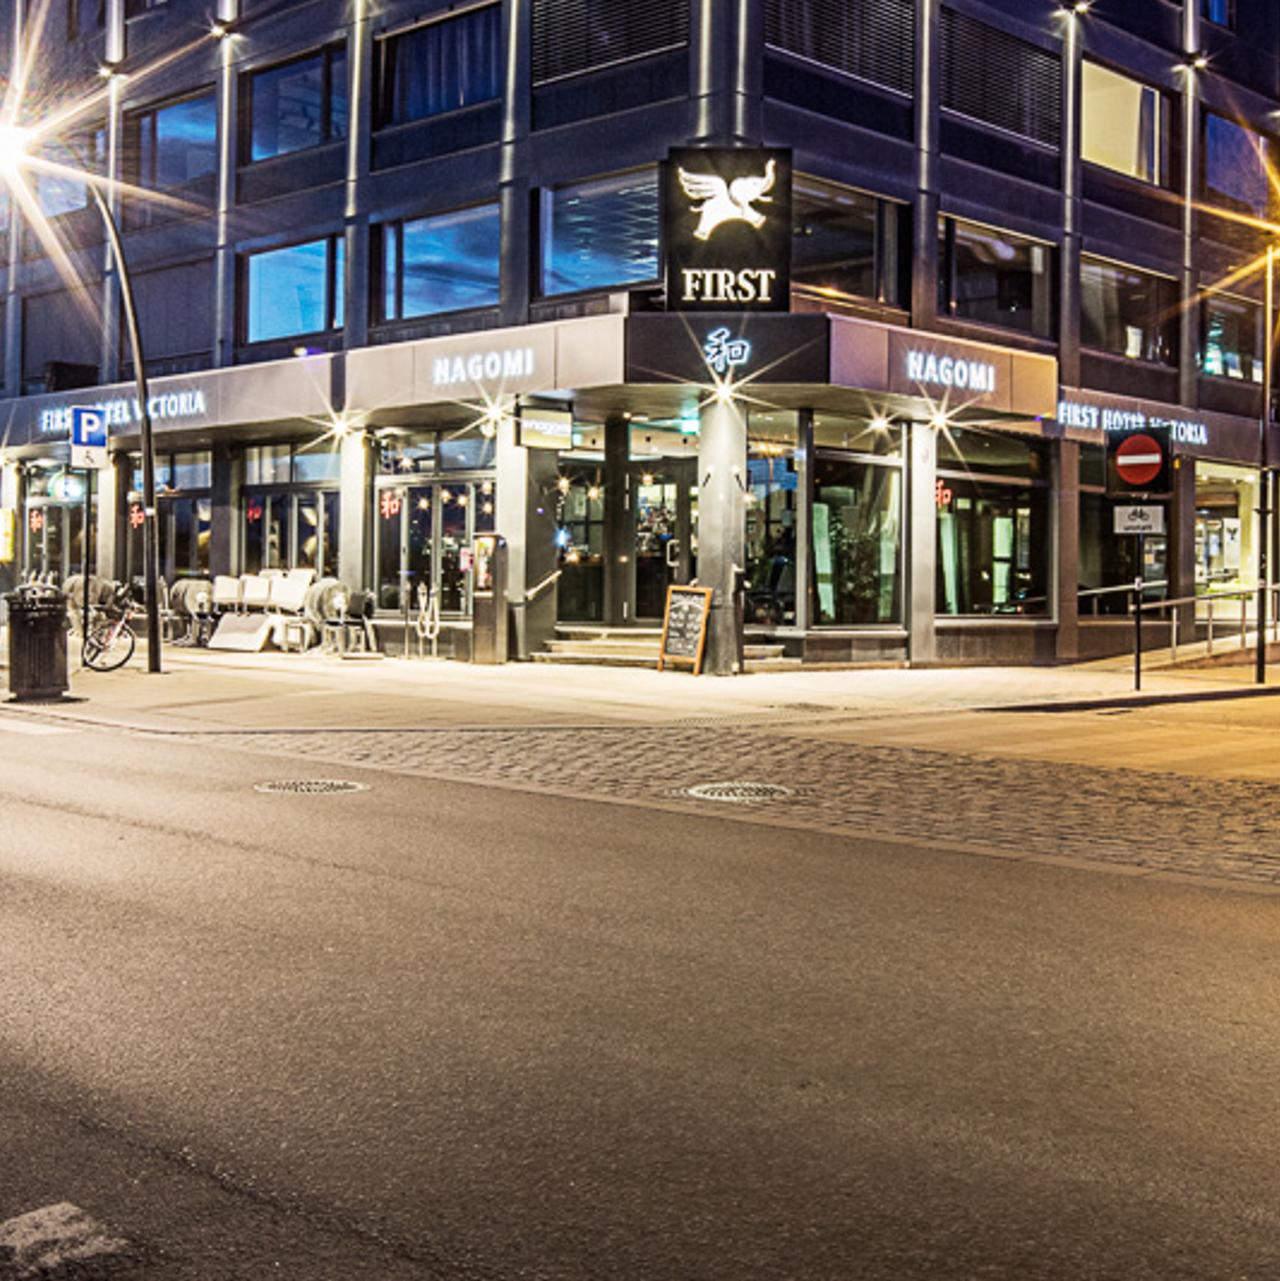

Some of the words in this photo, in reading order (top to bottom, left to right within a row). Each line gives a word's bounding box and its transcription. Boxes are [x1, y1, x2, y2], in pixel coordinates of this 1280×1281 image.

[681, 268, 777, 302] FIRST
[433, 348, 535, 385] NAGOMI
[704, 327, 751, 373] 和
[907, 350, 996, 393] NAGOMI
[41, 407, 71, 432] FIRS
[81, 413, 100, 443] P
[1058, 402, 1100, 430] FIRST
